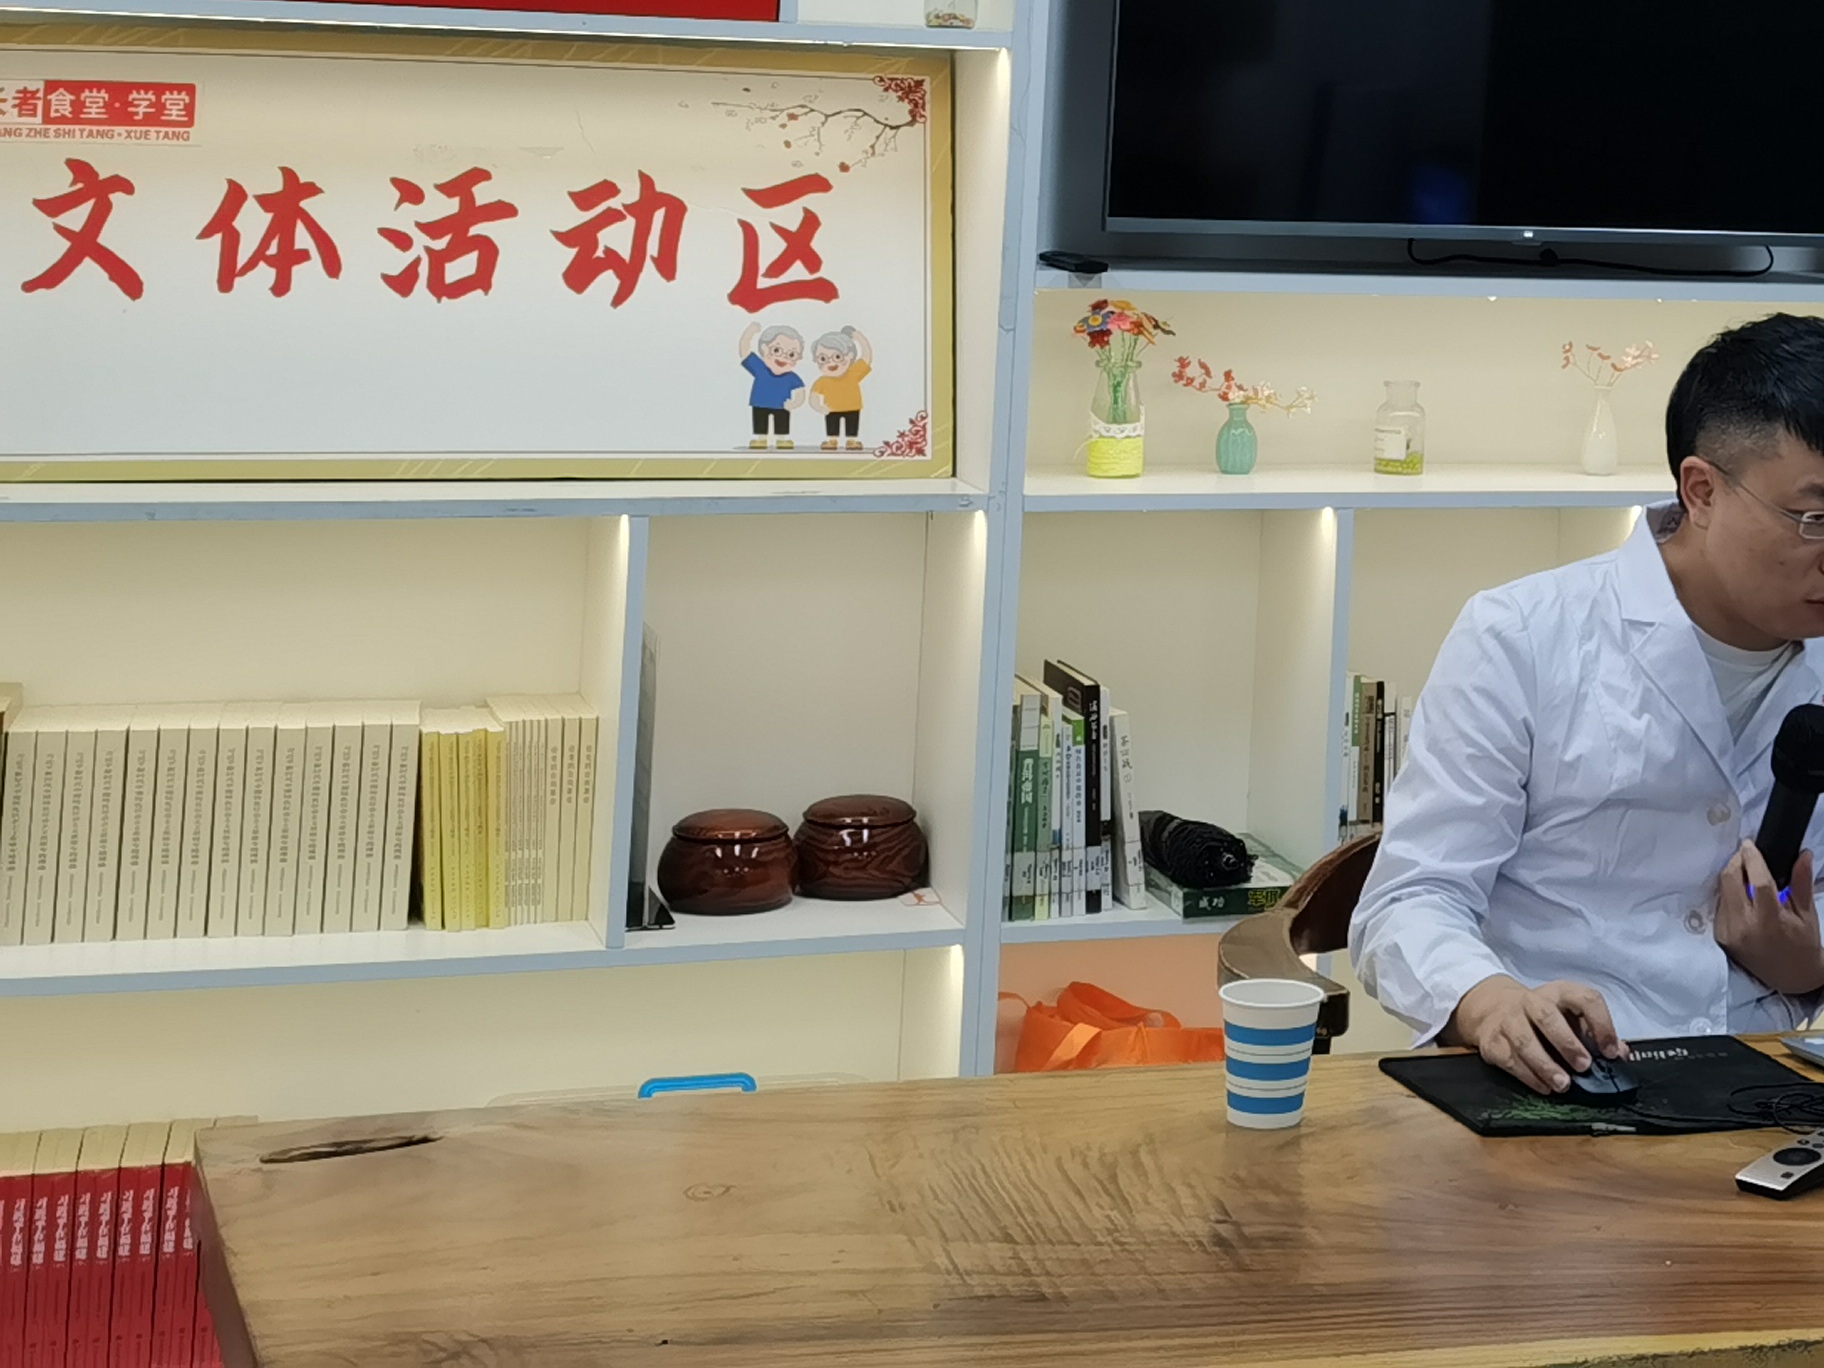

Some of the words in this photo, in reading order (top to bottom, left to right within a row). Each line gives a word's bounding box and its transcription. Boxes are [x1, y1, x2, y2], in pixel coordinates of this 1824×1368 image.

[25, 128, 50, 139] ZHE
[52, 128, 76, 139] SHI
[78, 128, 115, 140] TANG
[124, 130, 151, 140] XUE
[155, 130, 190, 142] TANG
[20, 157, 840, 314] 文体活动区
